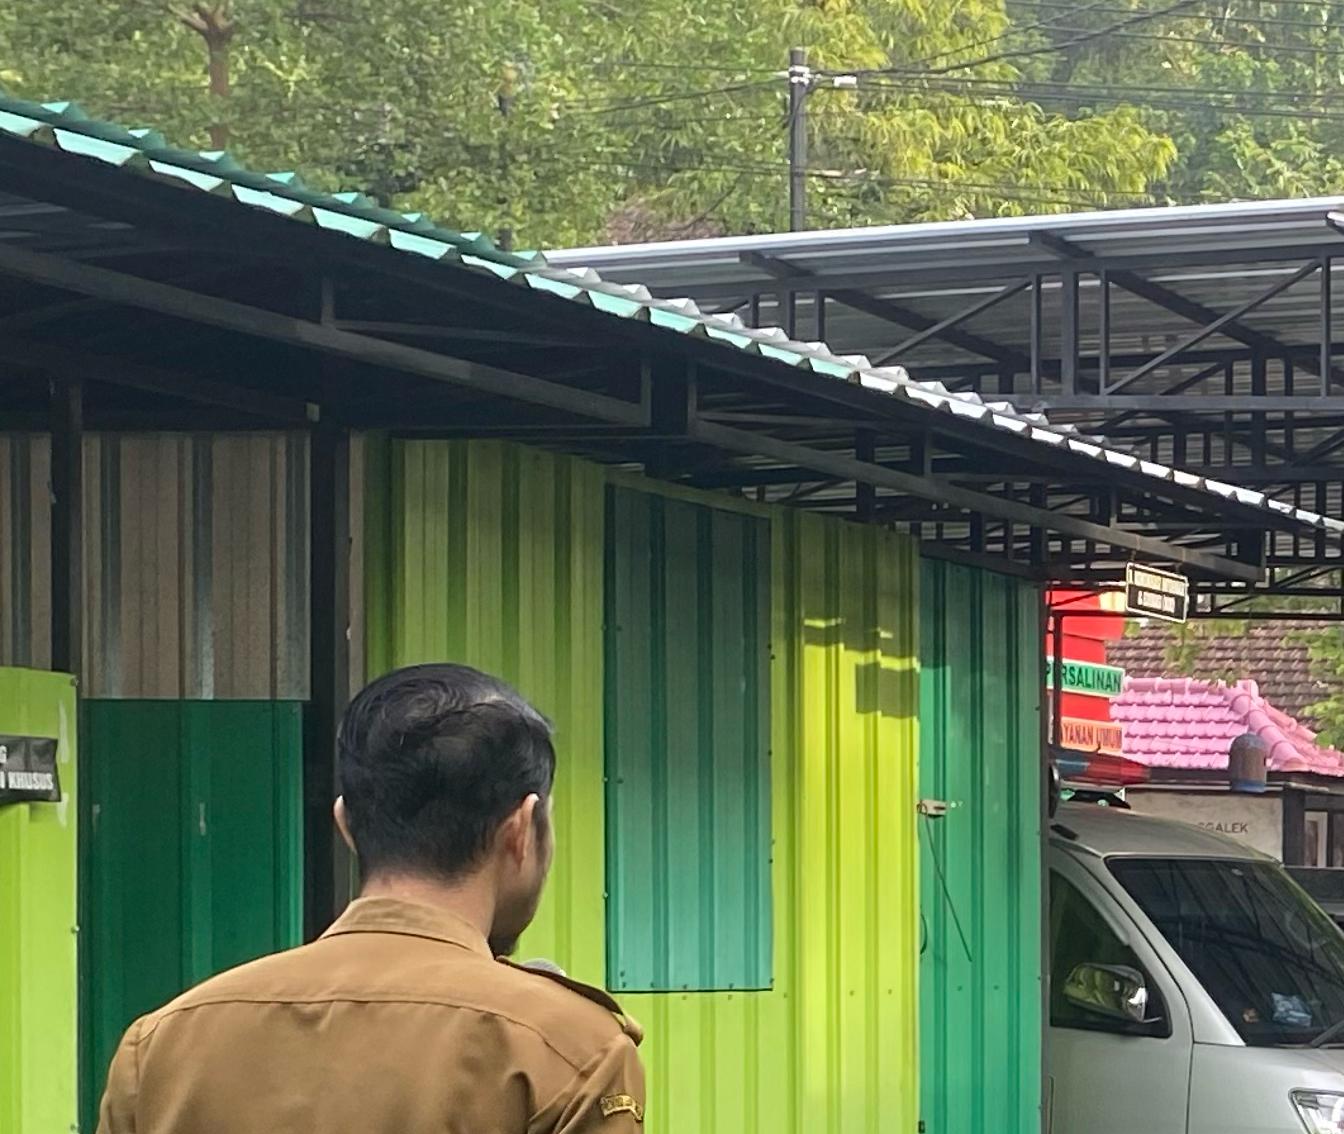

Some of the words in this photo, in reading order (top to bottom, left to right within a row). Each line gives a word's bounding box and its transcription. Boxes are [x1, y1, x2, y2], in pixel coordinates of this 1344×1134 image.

[1045, 663, 1121, 693] PRSALINAN
[1062, 722, 1094, 746] YANAN
[8, 771, 53, 790] KHUSUS
